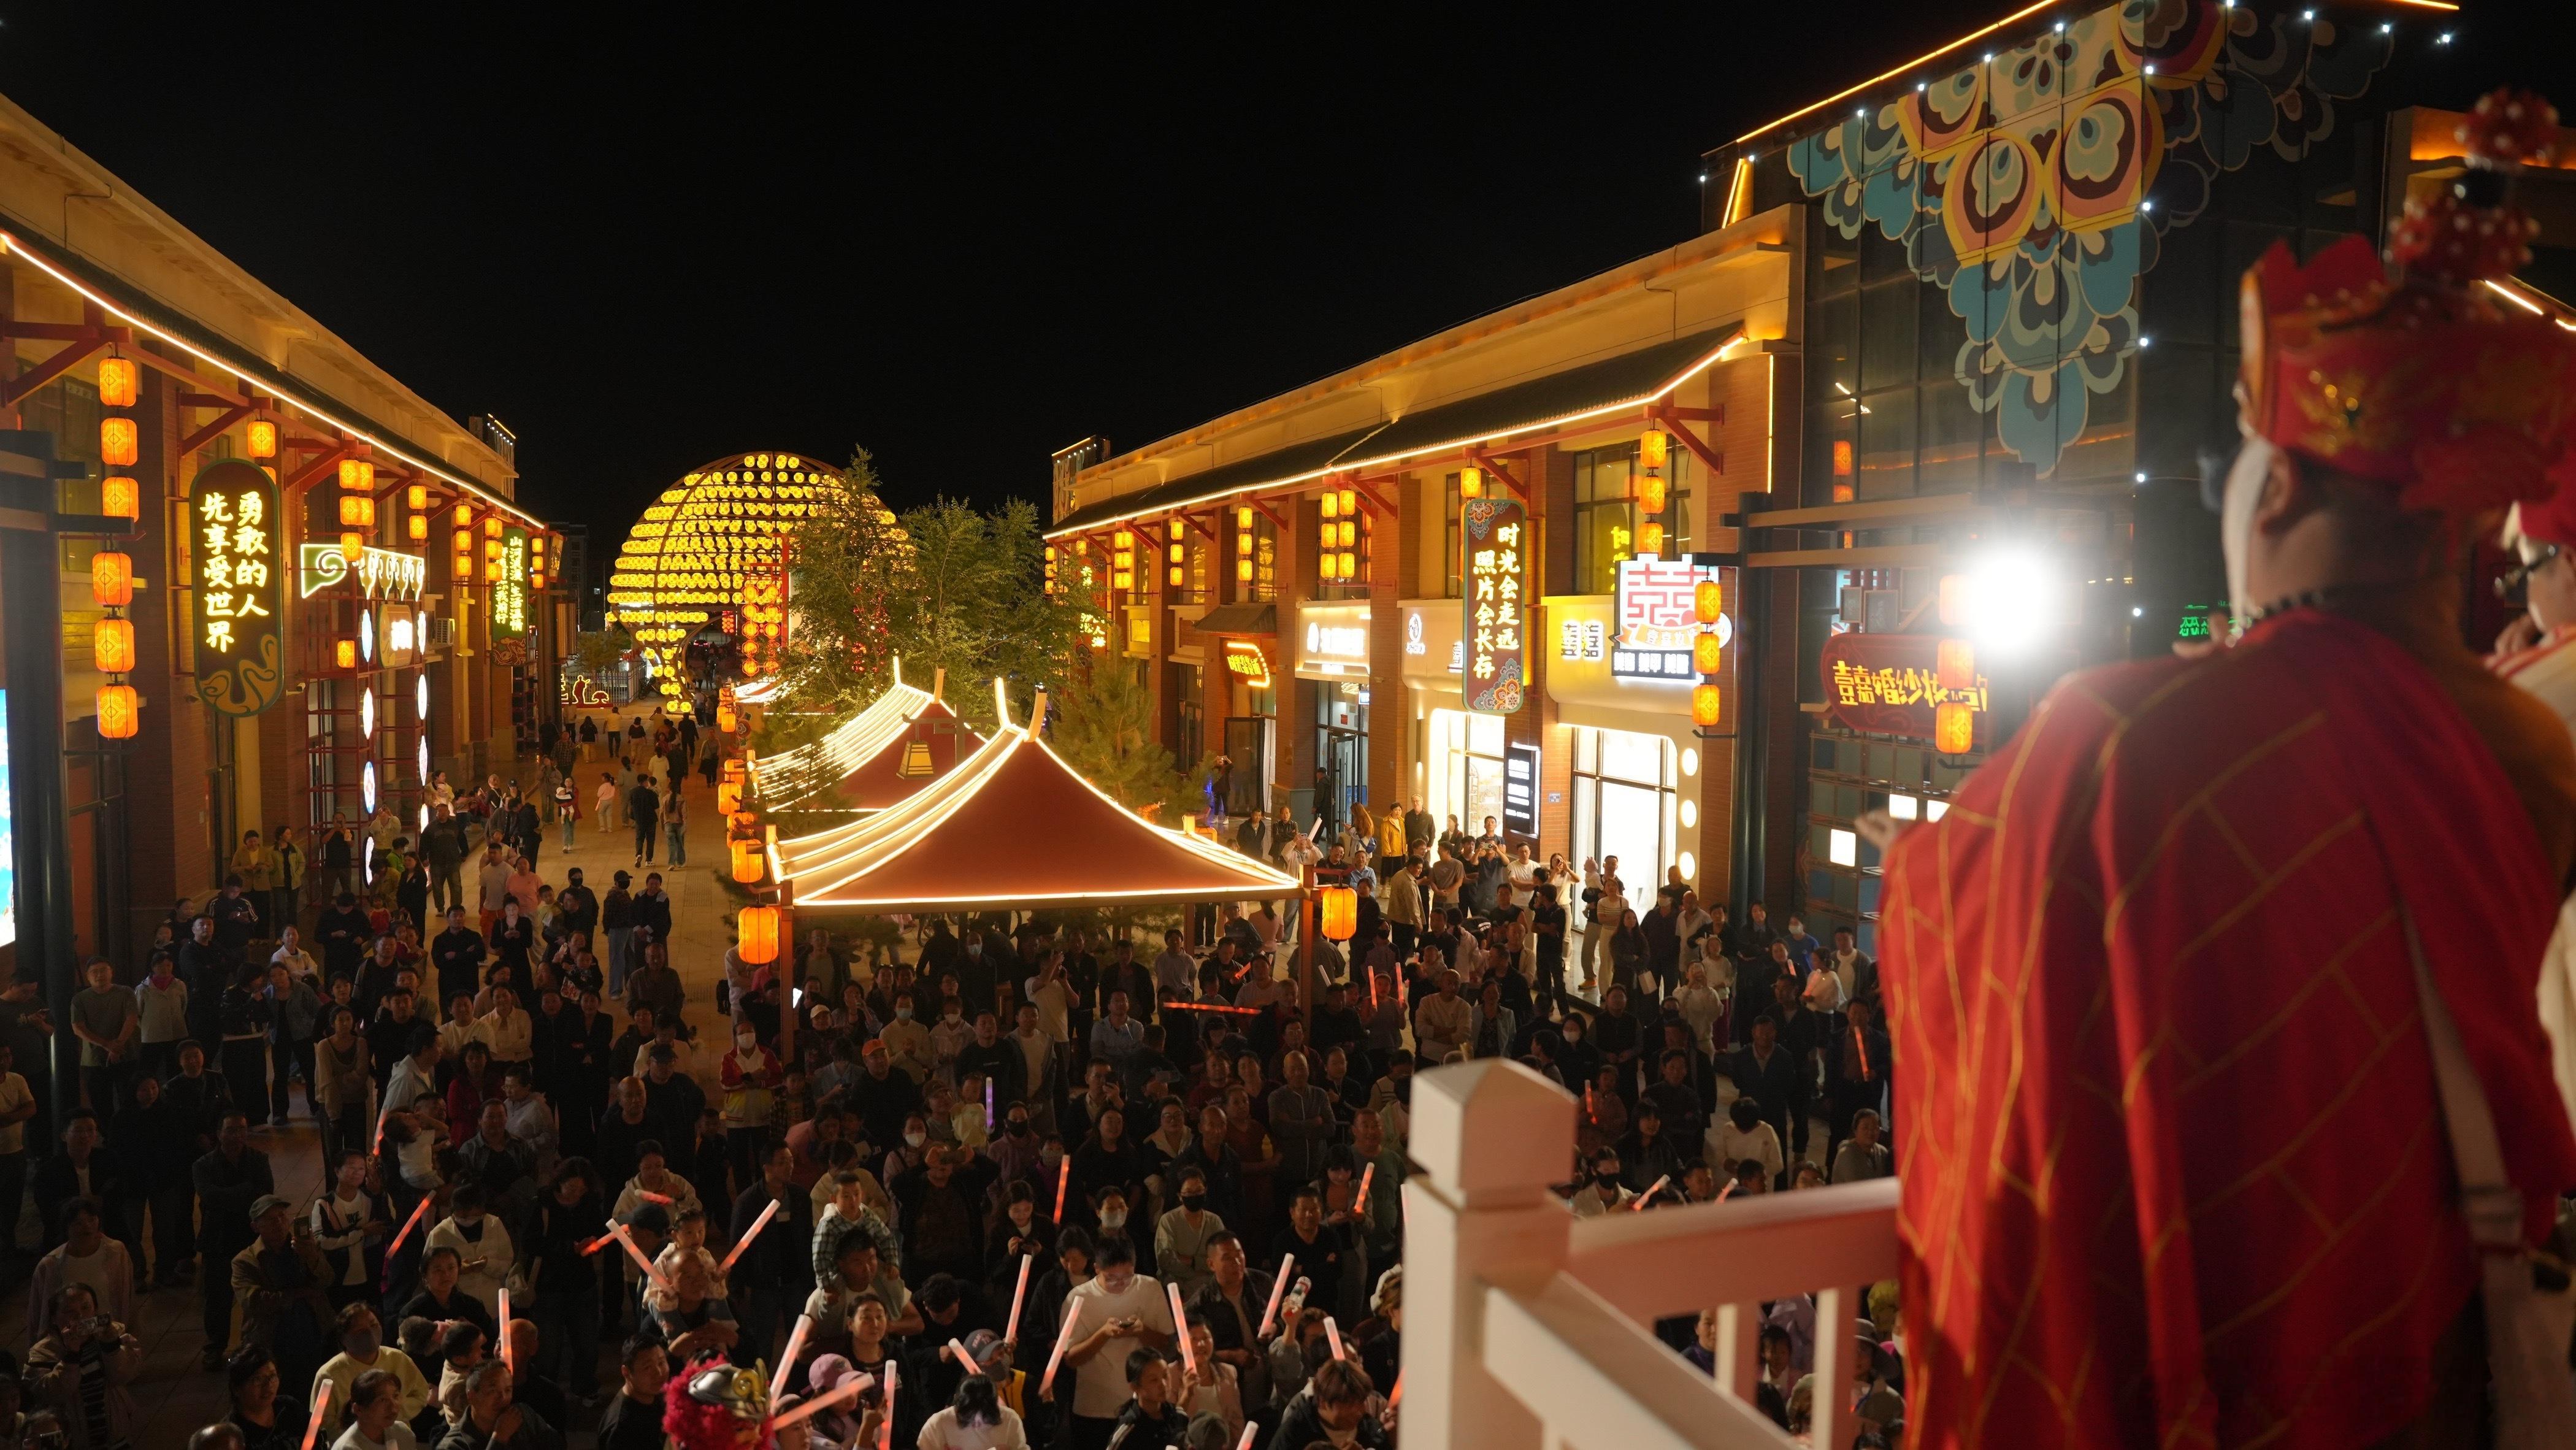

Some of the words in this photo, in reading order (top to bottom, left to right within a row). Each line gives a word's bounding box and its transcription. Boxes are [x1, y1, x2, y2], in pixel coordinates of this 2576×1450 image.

[200, 492, 236, 653] 先享受世界
[234, 491, 269, 617] 勇敢的人
[1473, 551, 1496, 679] 照片会长存
[1495, 523, 1520, 651] 时光会走远
